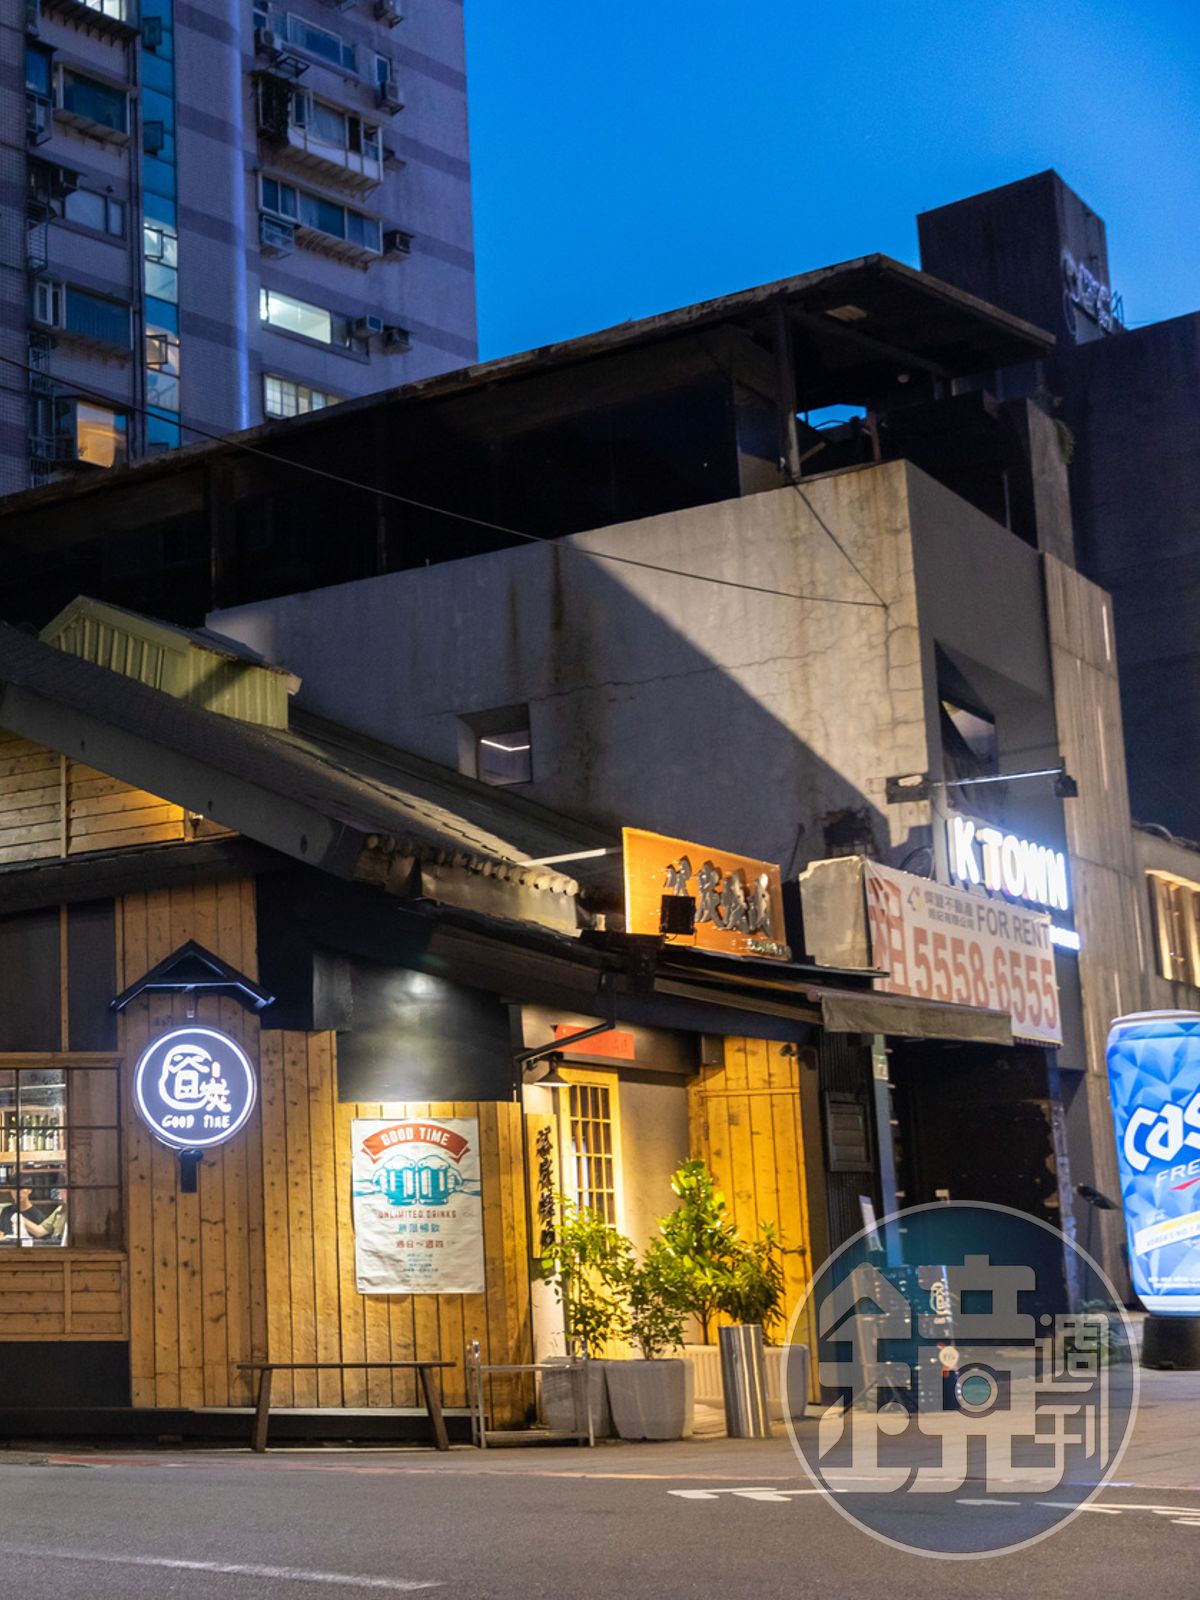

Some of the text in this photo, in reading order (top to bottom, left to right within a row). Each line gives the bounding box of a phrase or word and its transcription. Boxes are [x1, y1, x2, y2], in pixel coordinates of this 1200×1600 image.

[948, 817, 1068, 911] K TOWN
[976, 904, 1010, 939] FOR
[1013, 915, 1049, 950] RENT
[162, 1114, 231, 1128] GOOD TIME
[380, 1127, 450, 1146] GOOD TIME
[378, 1210, 456, 1218] UNLIMITED DRINKS
